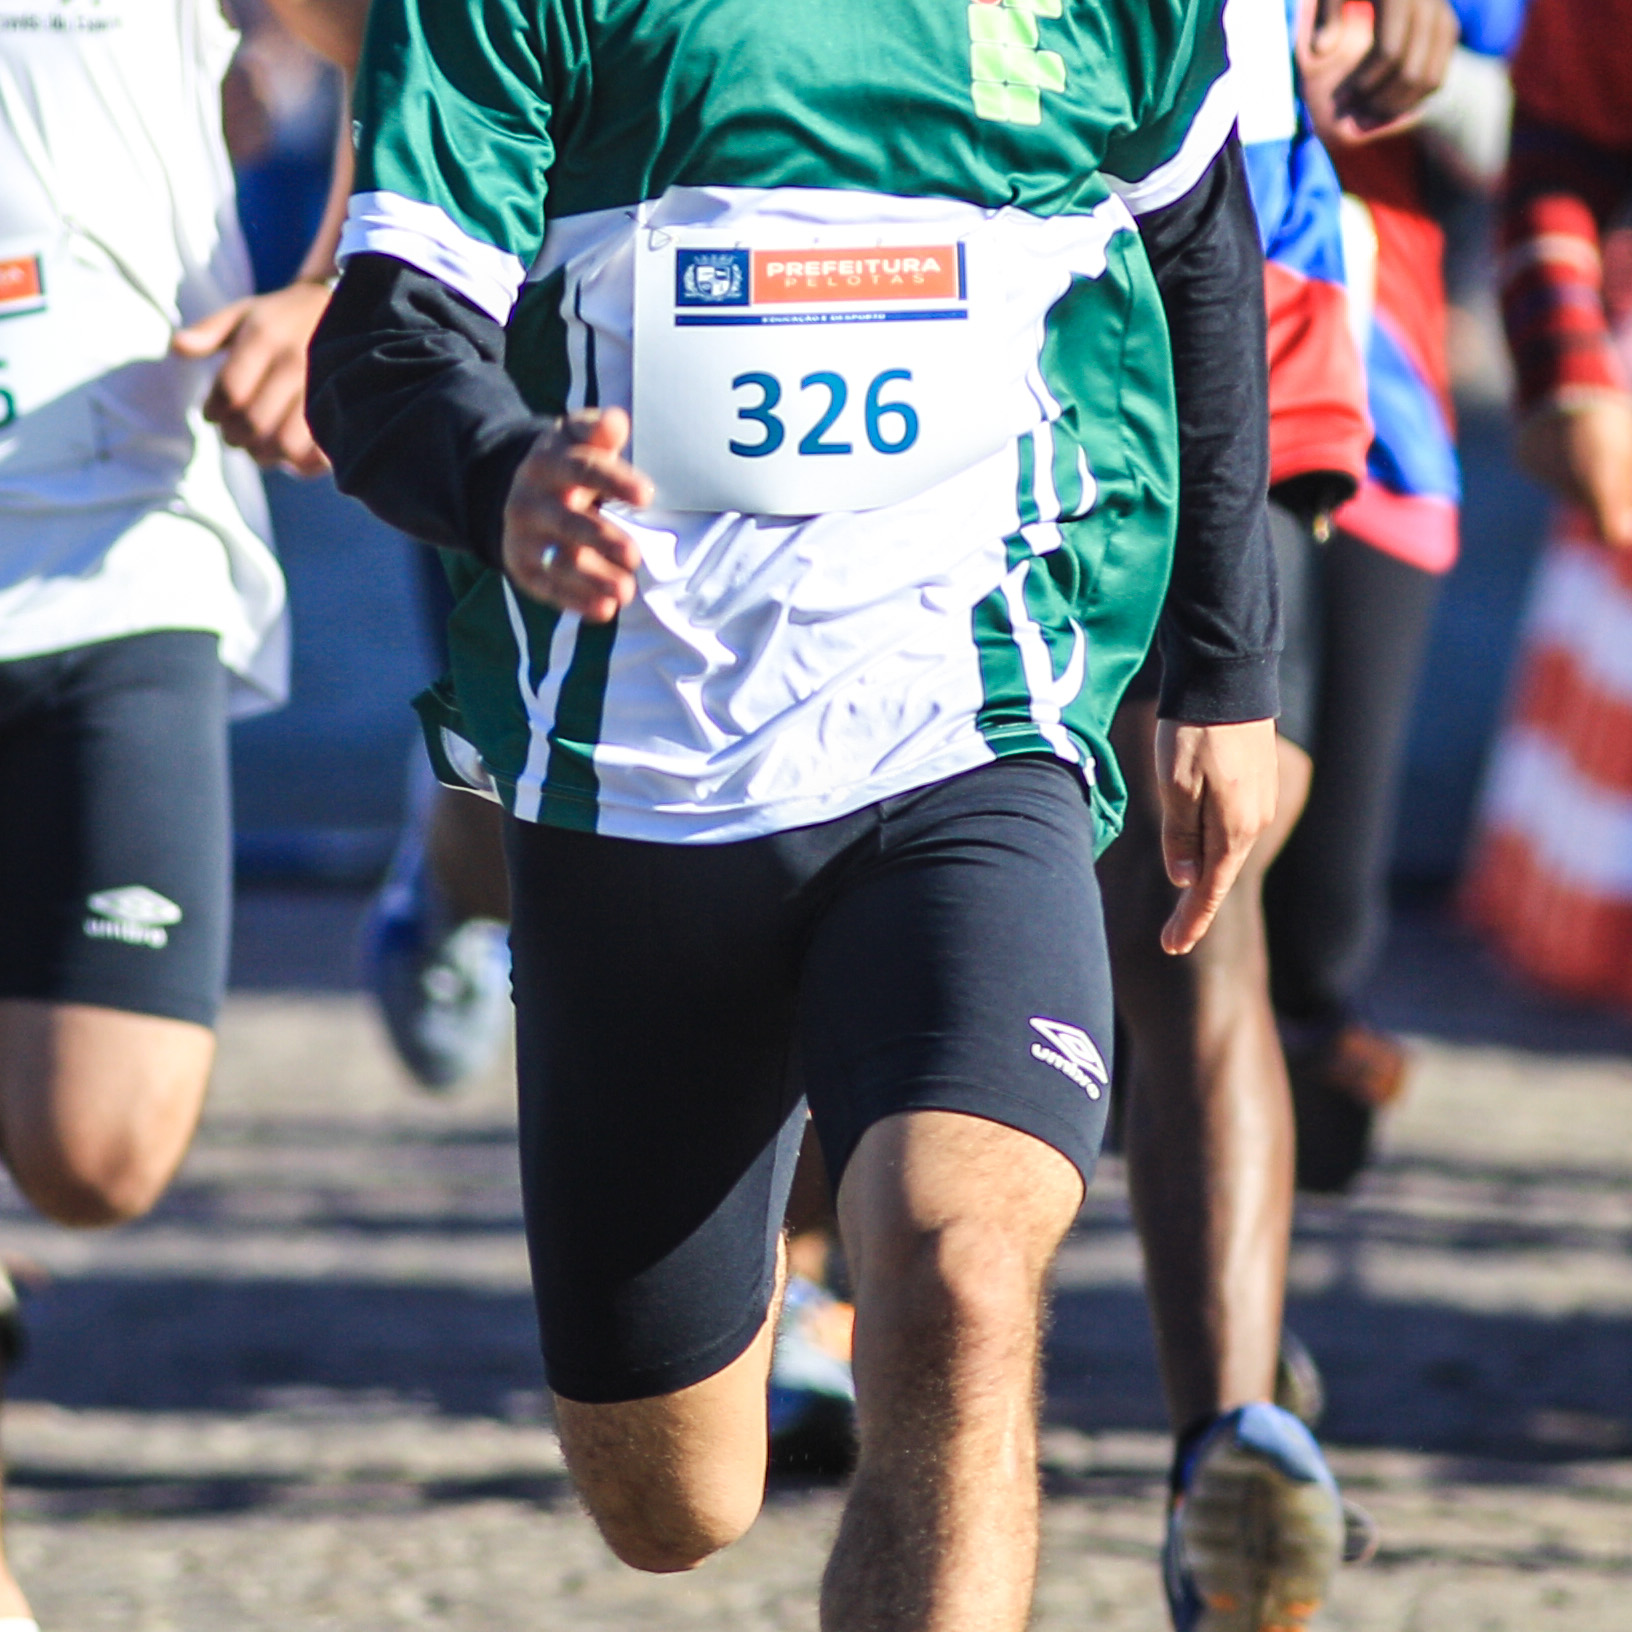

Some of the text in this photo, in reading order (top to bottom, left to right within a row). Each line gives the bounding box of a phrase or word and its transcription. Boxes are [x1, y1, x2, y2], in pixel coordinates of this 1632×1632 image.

[765, 256, 942, 279] PREFEITURA
[783, 273, 926, 288] PELOTAS
[727, 368, 921, 458] 326
[1030, 1042, 1102, 1101] umbro
